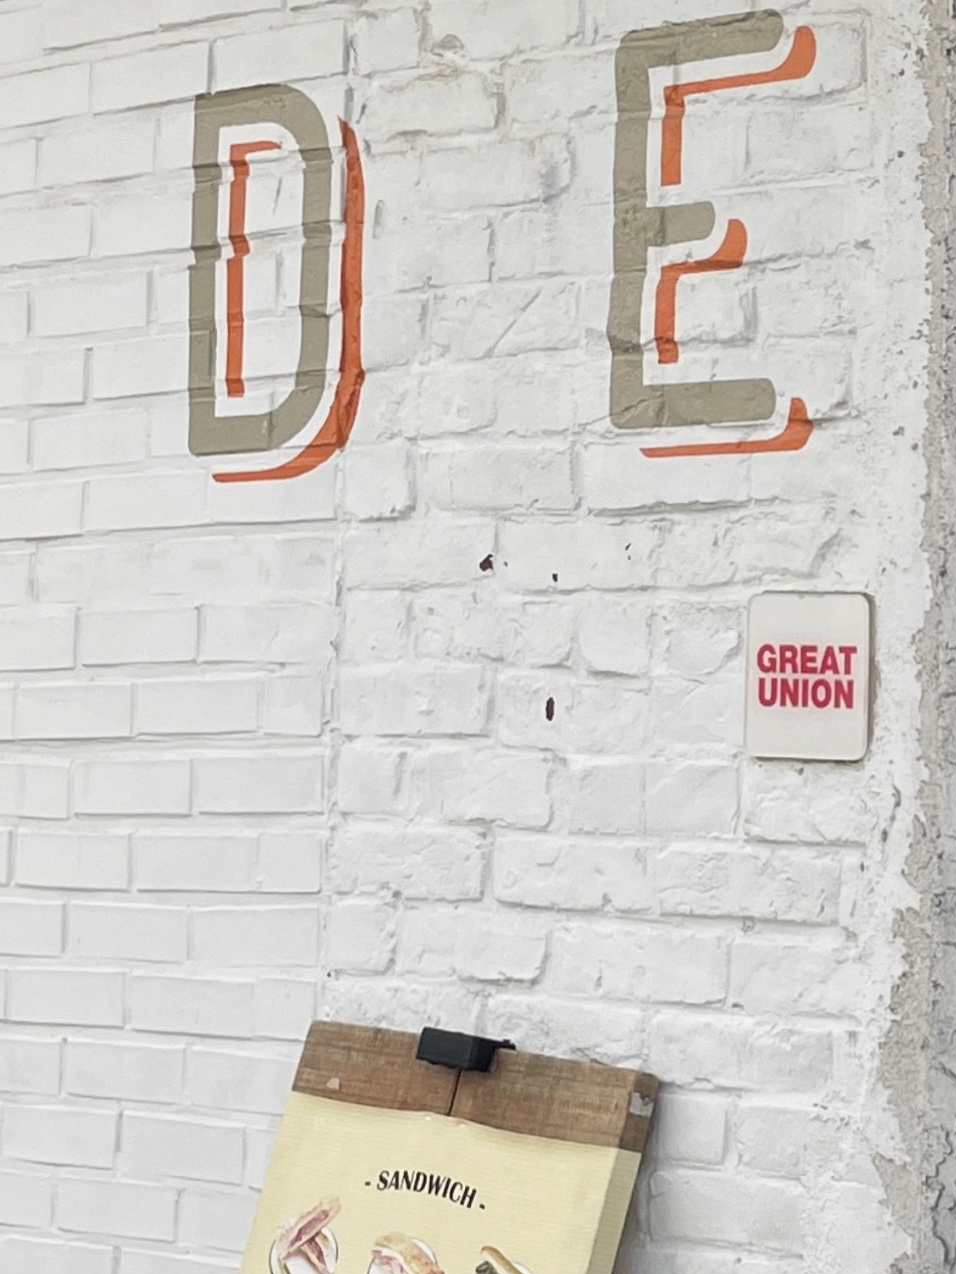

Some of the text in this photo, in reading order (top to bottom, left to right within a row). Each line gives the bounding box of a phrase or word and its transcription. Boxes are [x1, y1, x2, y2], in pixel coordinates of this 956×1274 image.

[188, 9, 817, 483] D E
[757, 644, 857, 675] GREAT
[758, 677, 854, 709] UNION
[377, 1170, 477, 1209] SANDWICH
